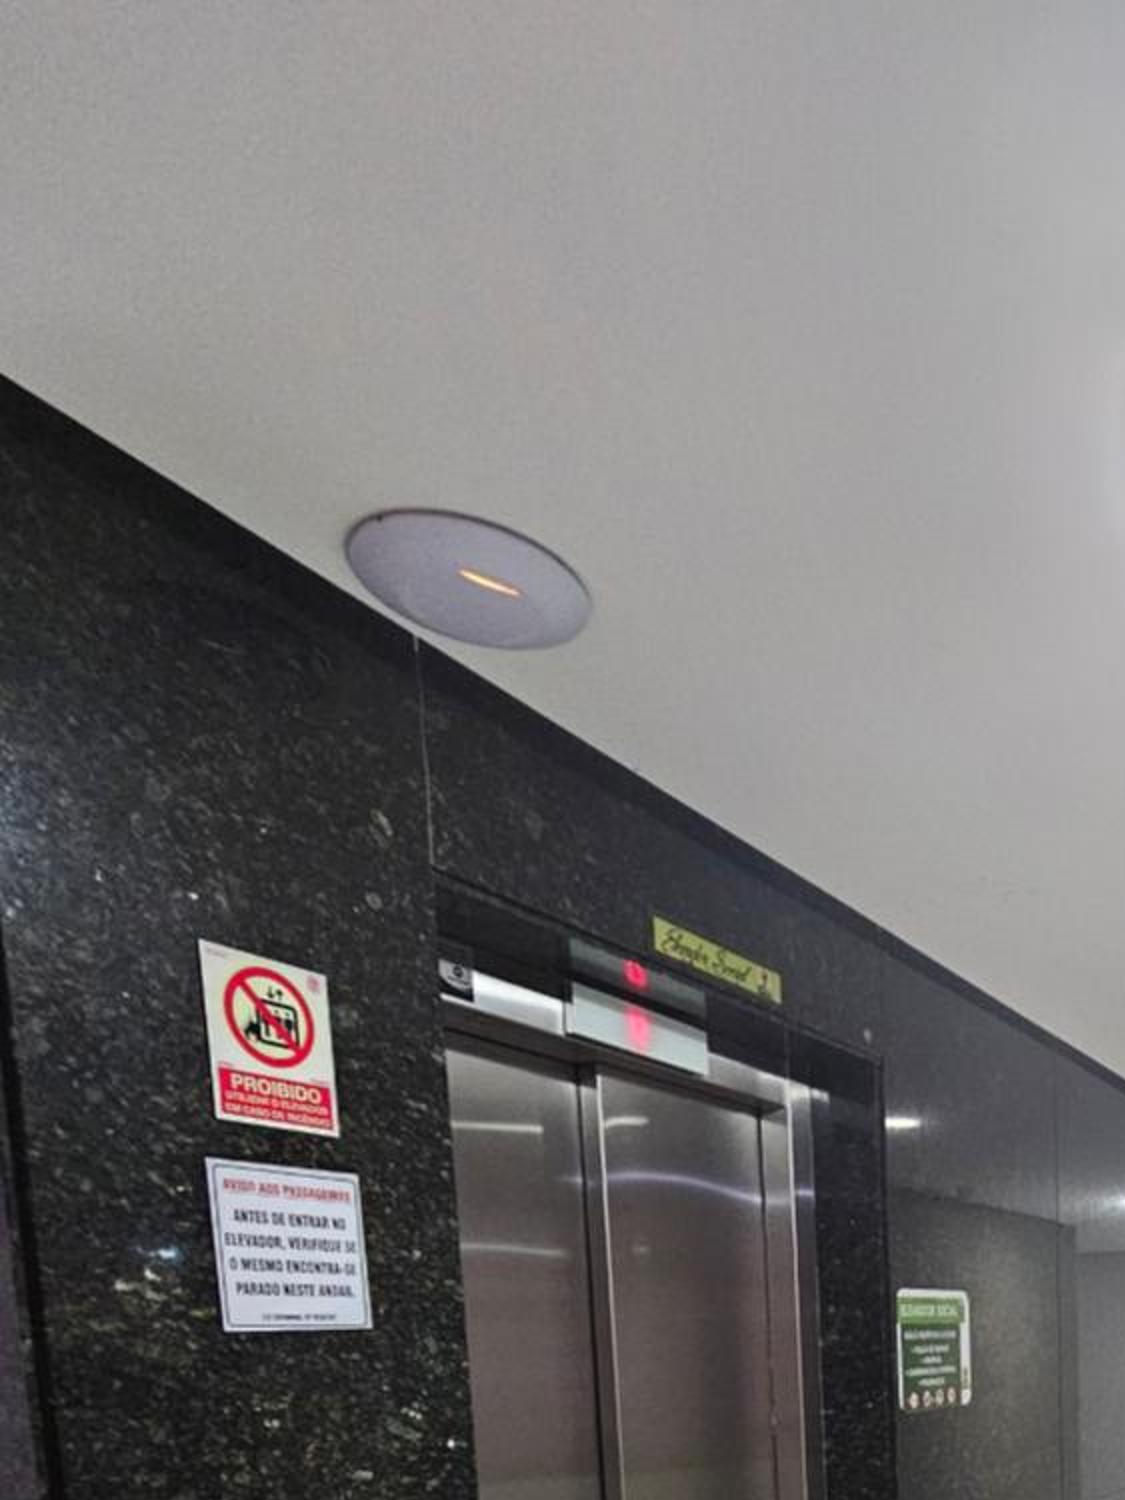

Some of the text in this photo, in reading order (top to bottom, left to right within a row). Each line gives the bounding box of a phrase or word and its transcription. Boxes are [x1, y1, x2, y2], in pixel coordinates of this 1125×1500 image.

[230, 1073, 321, 1104] PROIBIDO
[234, 1209, 346, 1230] ANTES DE ENTRAR NO
[224, 1232, 356, 1253] ELEVADOR, VERIFIQUE SE
[229, 1257, 355, 1276] O MESMO ENCONTRA-SE
[236, 1282, 281, 1297] PARADO
[283, 1284, 315, 1297] NESTE
